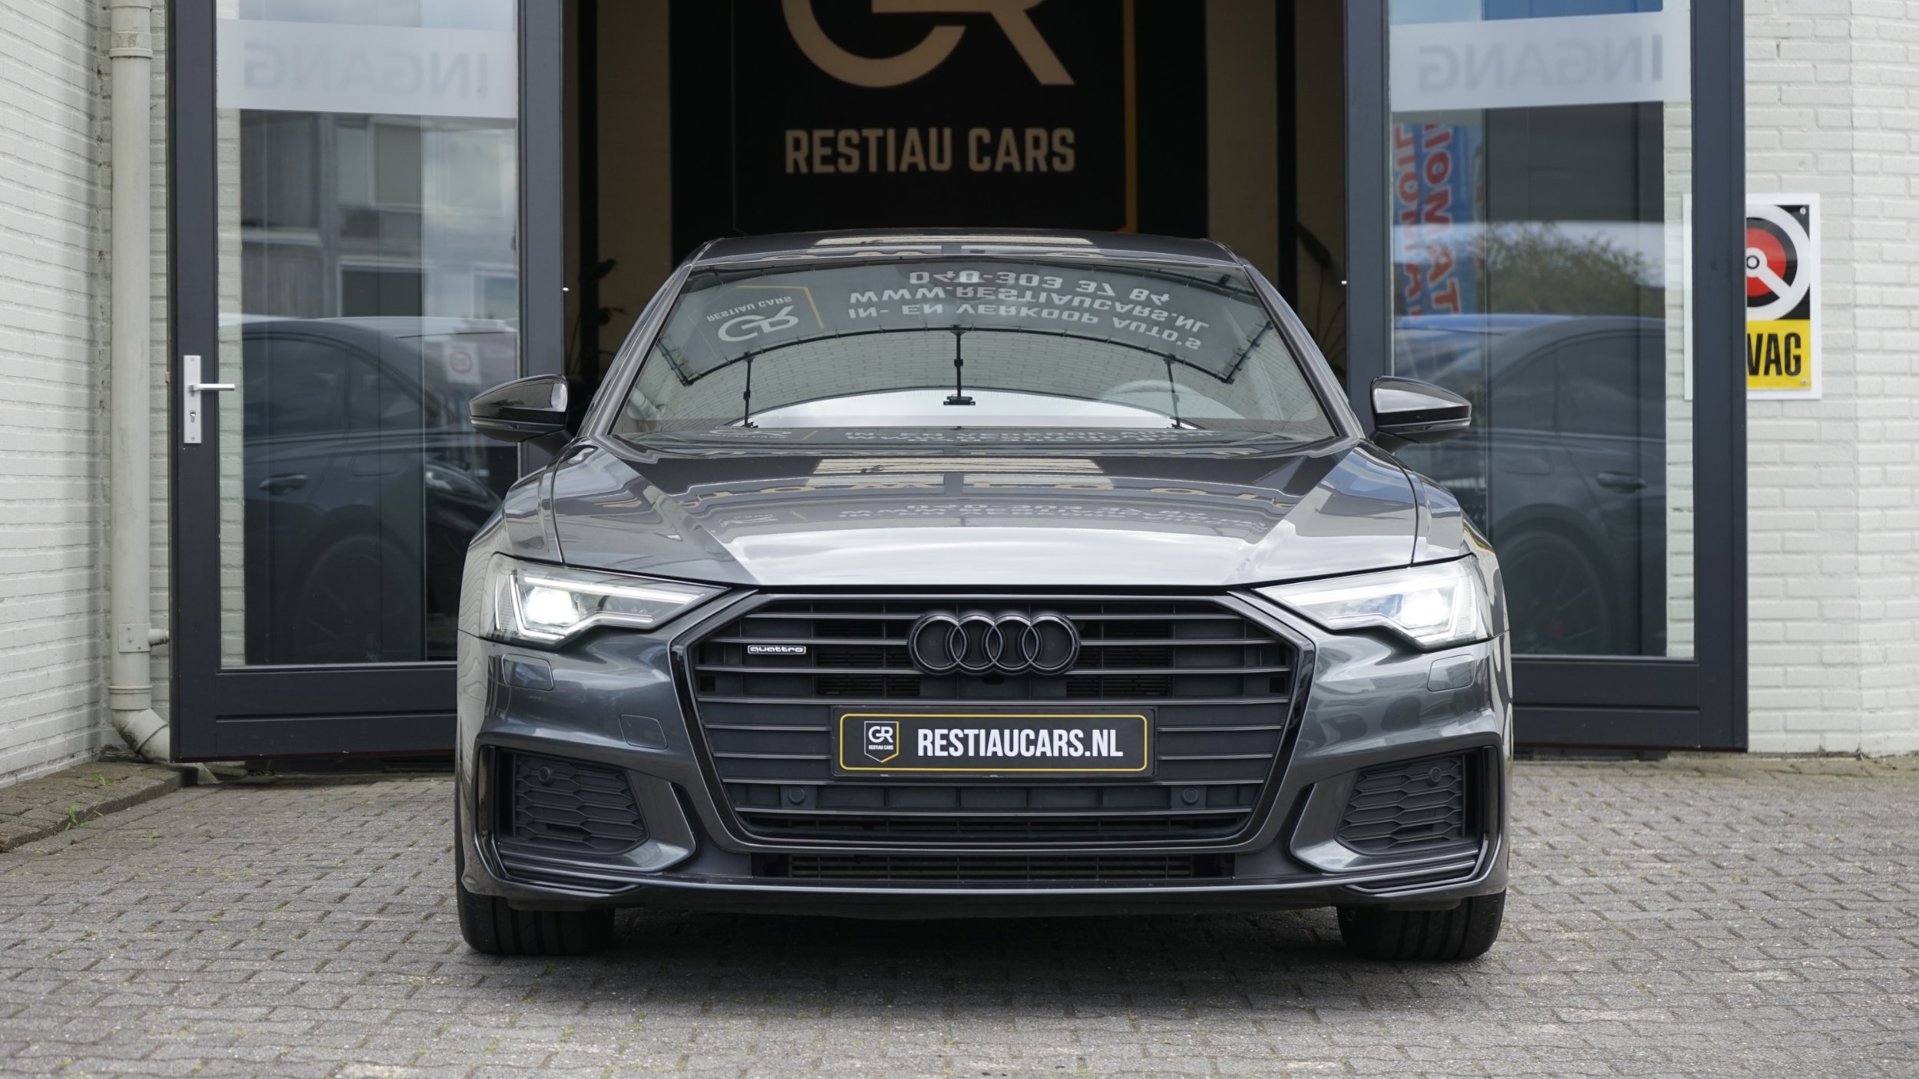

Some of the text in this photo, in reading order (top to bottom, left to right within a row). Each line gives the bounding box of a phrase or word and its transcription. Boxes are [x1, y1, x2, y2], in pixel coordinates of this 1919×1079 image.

[784, 127, 1076, 174] RESTIAU CARS
[750, 645, 804, 654] quattro
[868, 725, 894, 743] GR
[917, 728, 1124, 757] RESTIAUCARS.NL
